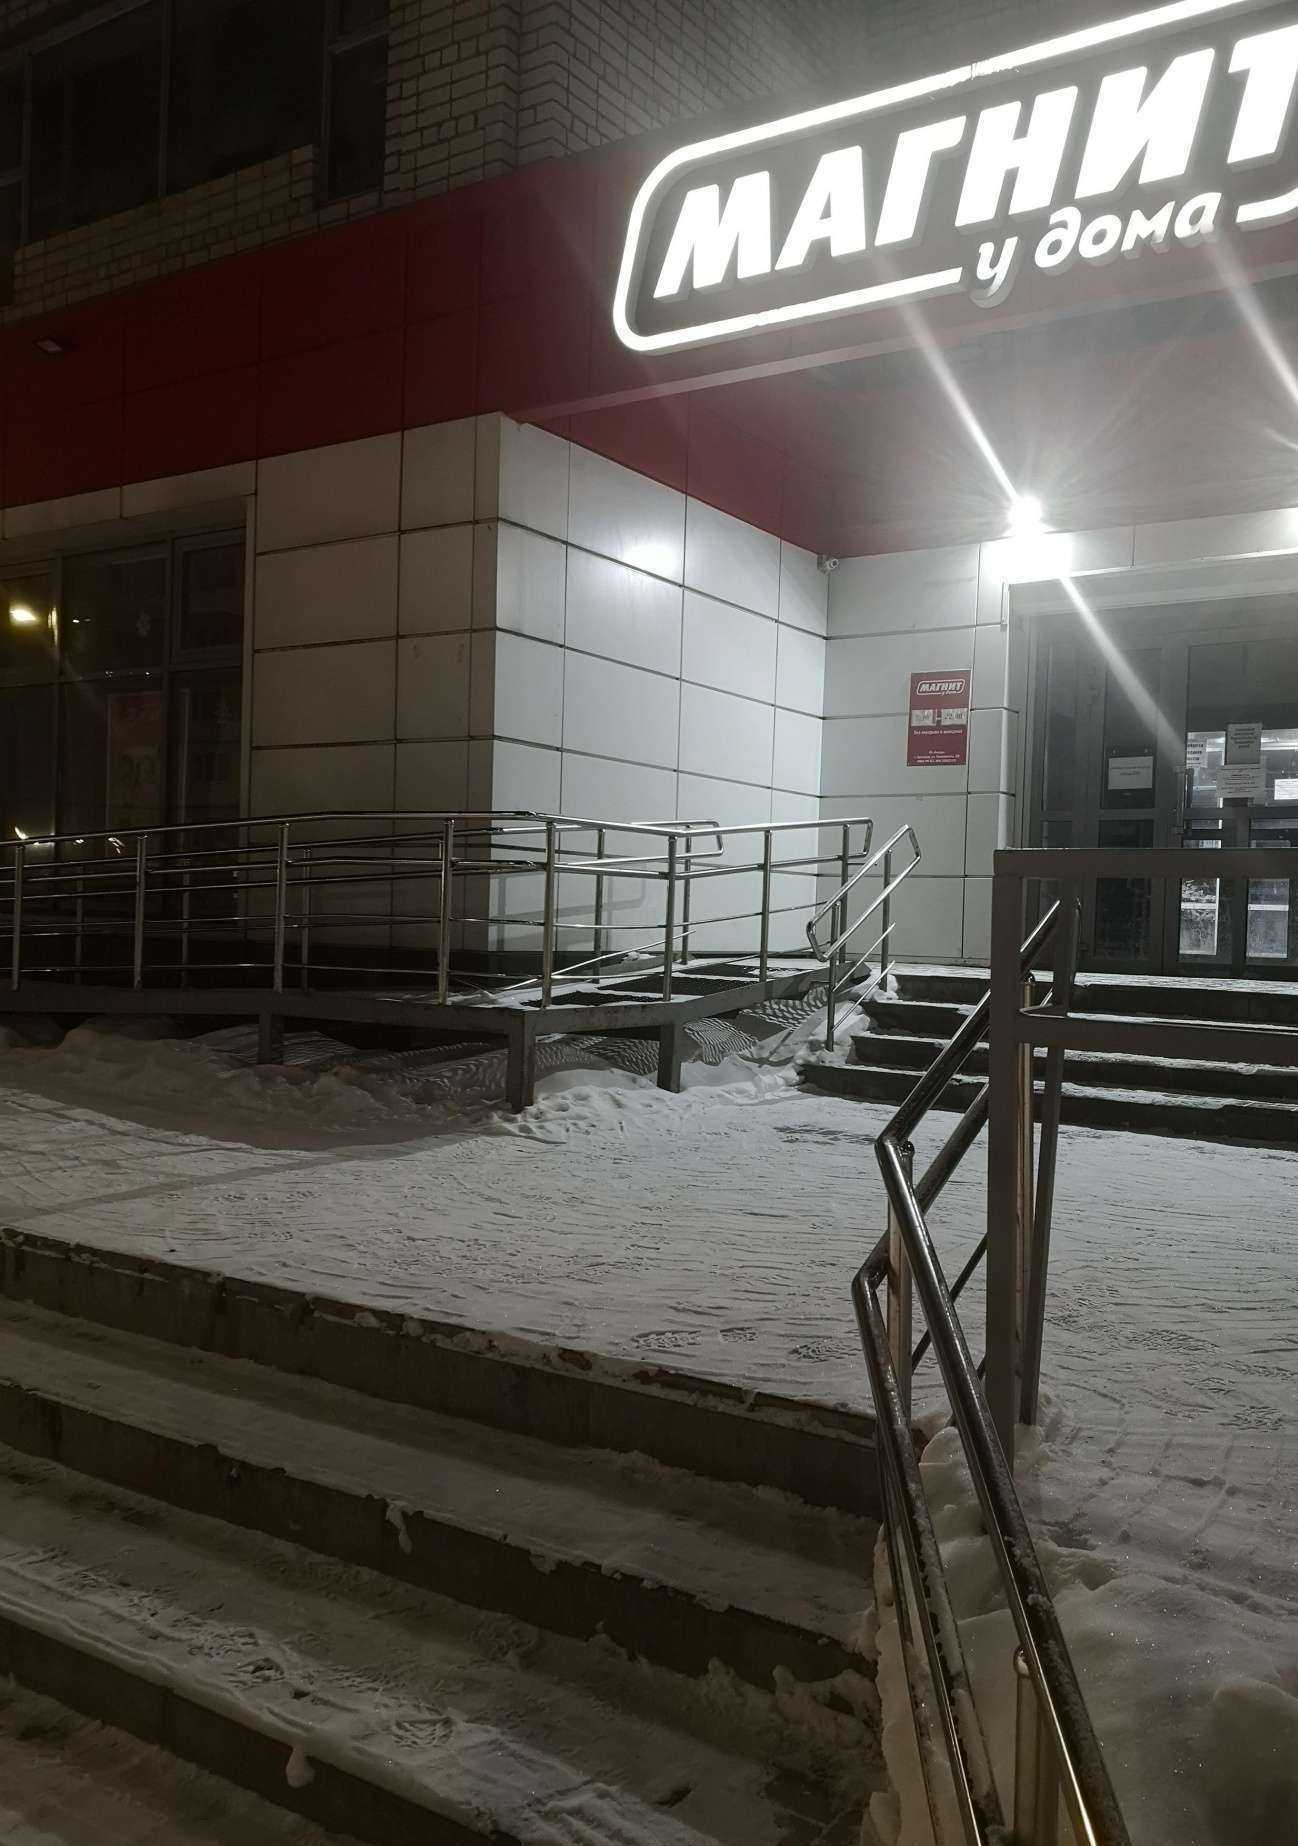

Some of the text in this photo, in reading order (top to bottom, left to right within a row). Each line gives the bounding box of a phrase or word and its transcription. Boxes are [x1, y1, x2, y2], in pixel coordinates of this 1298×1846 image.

[653, 24, 1298, 299] МАГНИТ
[976, 192, 1222, 298] у дома
[920, 682, 962, 692] МАГНИТ
